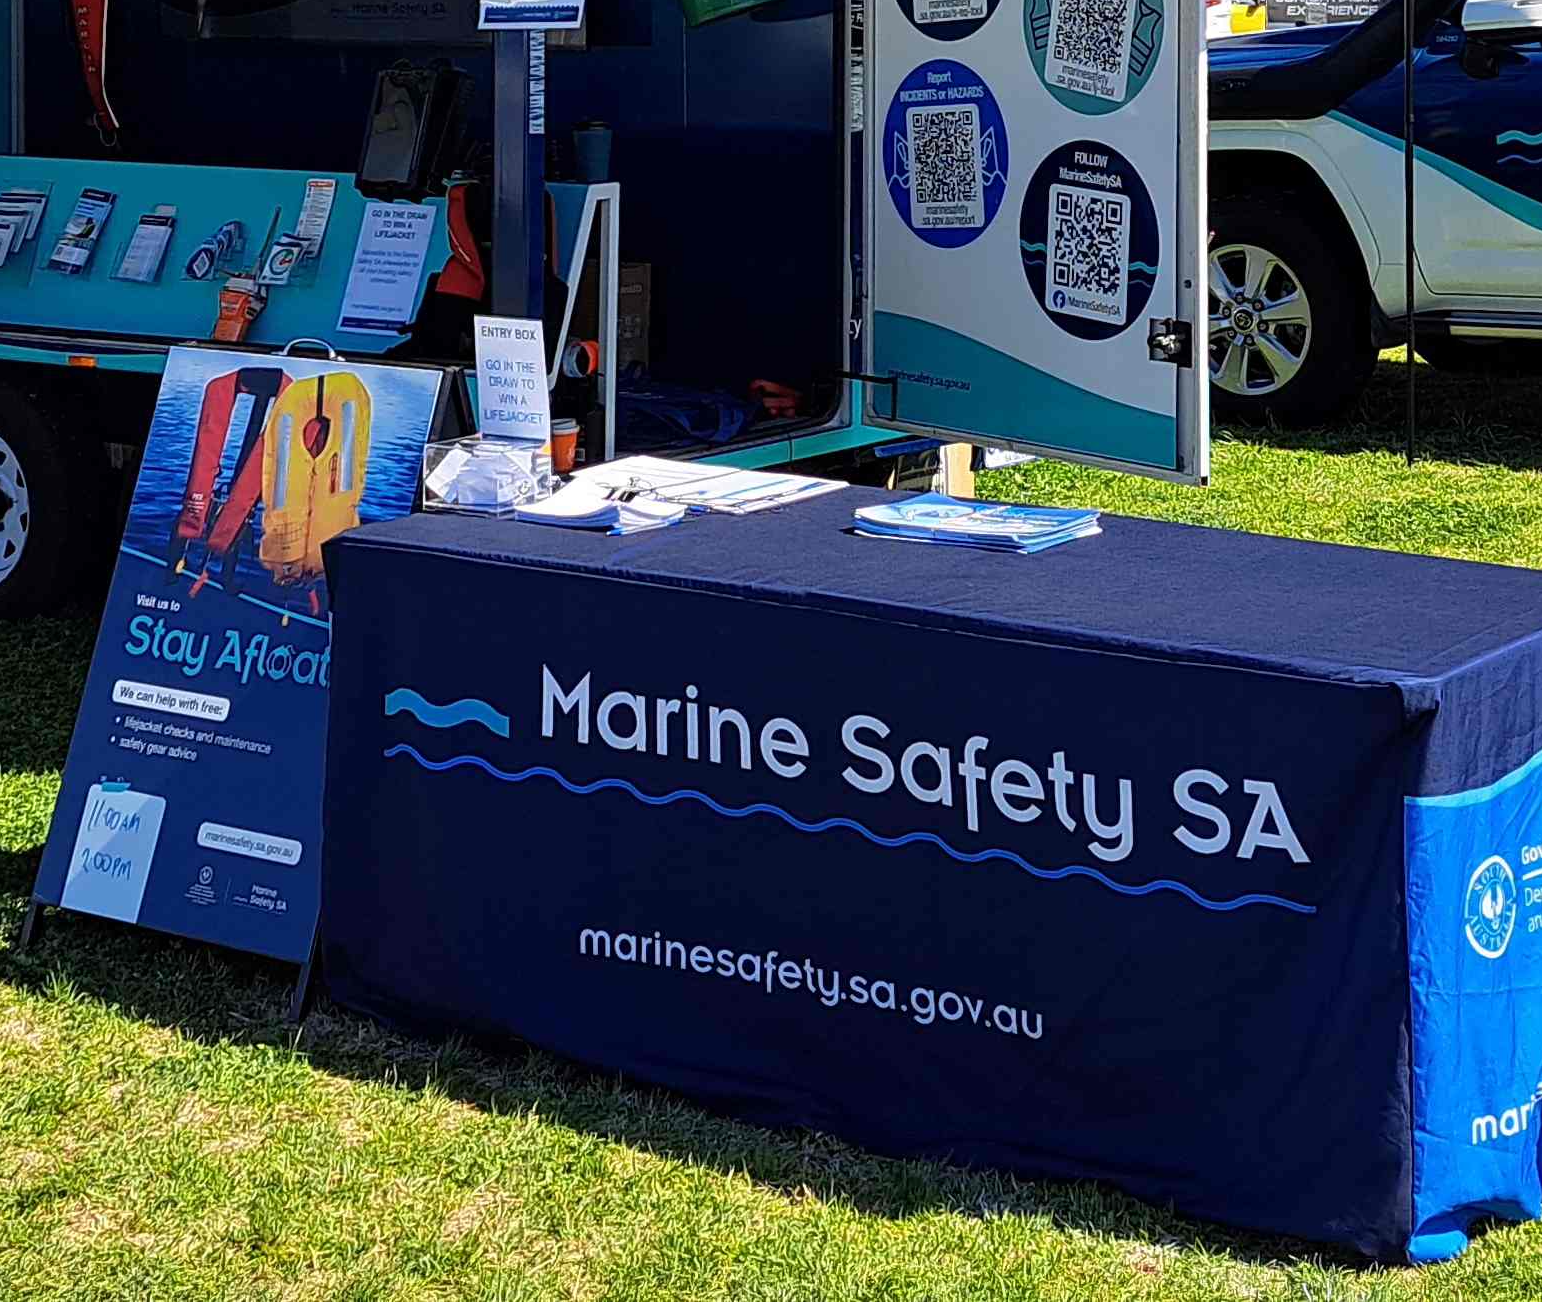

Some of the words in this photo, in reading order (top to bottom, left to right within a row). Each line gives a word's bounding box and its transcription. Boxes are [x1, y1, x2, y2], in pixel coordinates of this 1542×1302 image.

[900, 89, 936, 103] INCIDENTS
[948, 85, 985, 100] HAZARDS
[1074, 151, 1108, 169] FOLLOW
[481, 326, 512, 339] ENTRY
[515, 328, 537, 341] BOX
[485, 359, 501, 371] GO
[503, 360, 514, 372] IN
[515, 362, 536, 374] THE
[488, 376, 518, 389] DRAW
[521, 378, 535, 391] TO
[498, 393, 518, 406] WIN
[520, 395, 528, 406] A
[484, 409, 544, 426] LIFEJACKET
[136, 594, 156, 607] Visit
[157, 598, 170, 610] us
[171, 599, 181, 612] to
[125, 615, 210, 677] Stay
[120, 685, 135, 699] We
[136, 690, 155, 702] can
[156, 692, 176, 708] help
[178, 699, 199, 710] with
[201, 704, 223, 716] free:
[123, 715, 162, 734] lifejacket
[164, 725, 195, 741] checks
[196, 731, 214, 744] and
[215, 735, 272, 755] maintenance
[119, 737, 146, 754] safety
[147, 742, 168, 756] gear
[168, 746, 198, 762] advice
[541, 663, 809, 780] Marine
[841, 714, 1134, 863] Safety
[1172, 769, 1311, 864] SA
[580, 926, 1045, 1041] marinesafety.sa.gov.au
